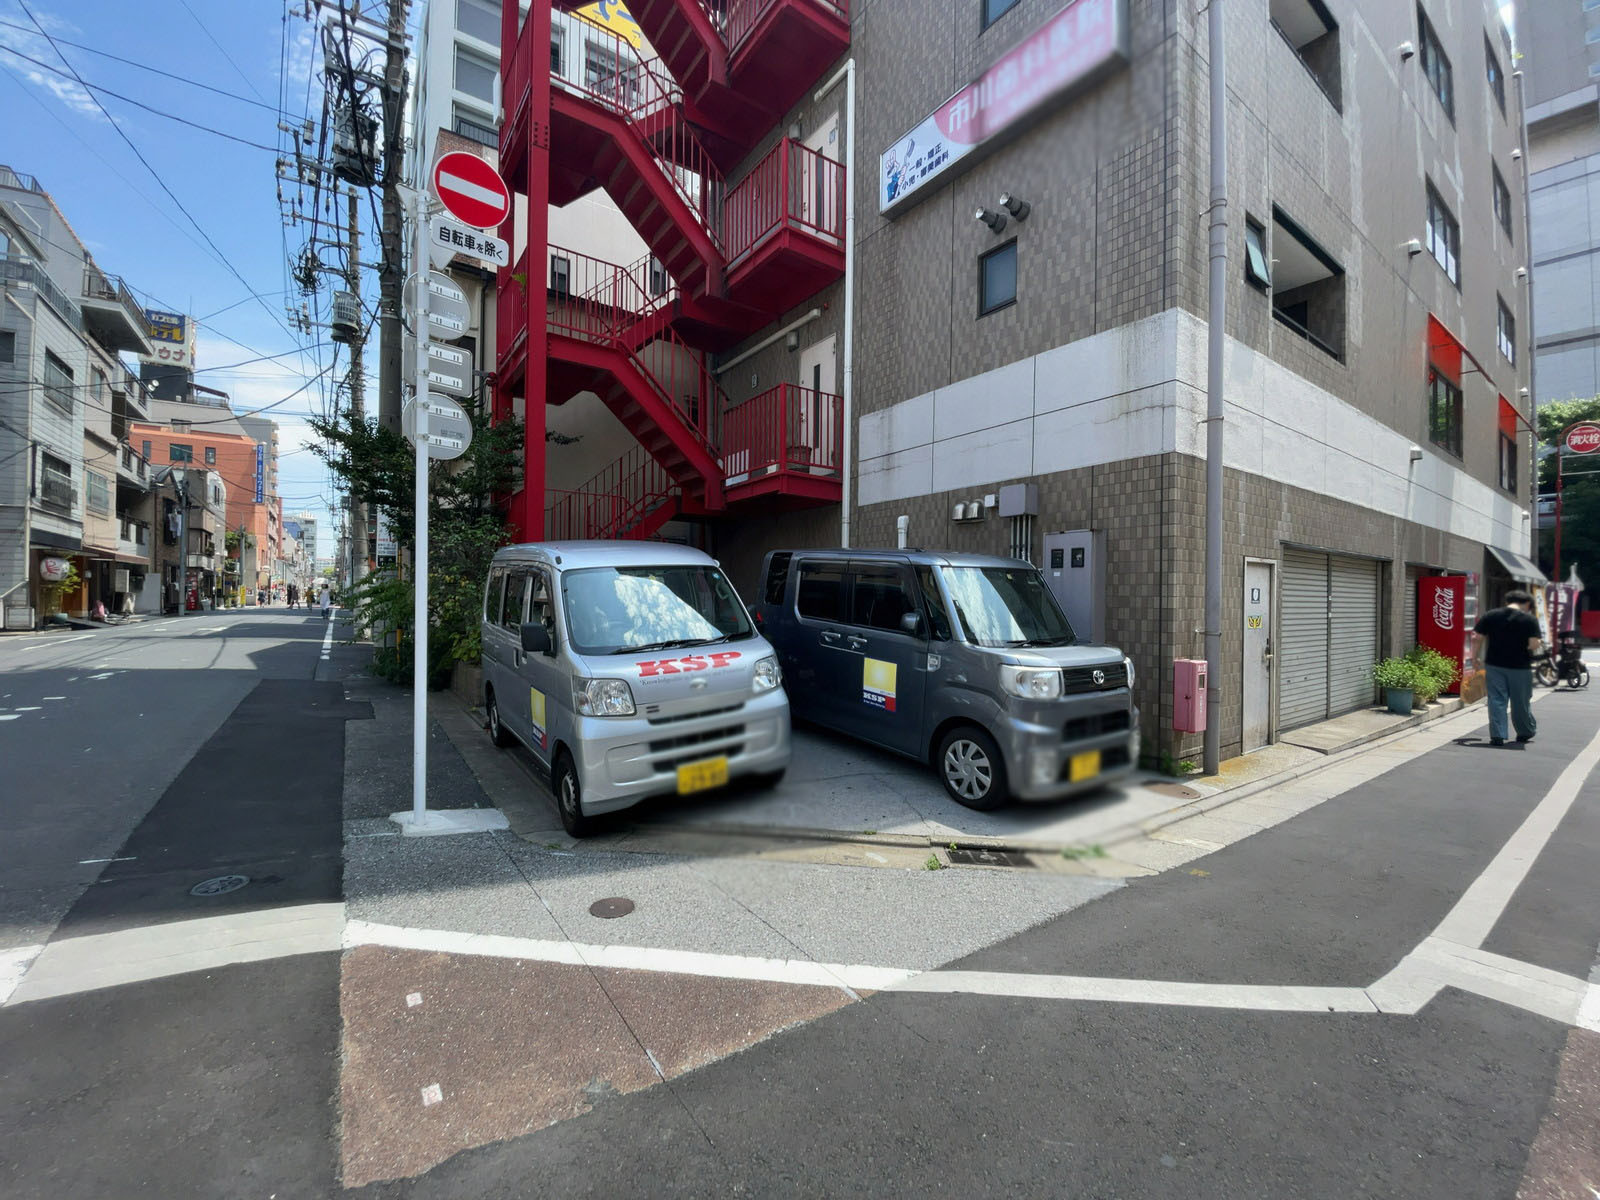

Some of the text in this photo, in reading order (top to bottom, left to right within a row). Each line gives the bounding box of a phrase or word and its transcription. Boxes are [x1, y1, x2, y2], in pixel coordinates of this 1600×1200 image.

[439, 226, 503, 261] 自転車を除く
[1570, 433, 1600, 446] 消火栓
[1434, 586, 1454, 630] Coca-Cola
[634, 651, 742, 677] KSP
[863, 691, 886, 703] KSP
